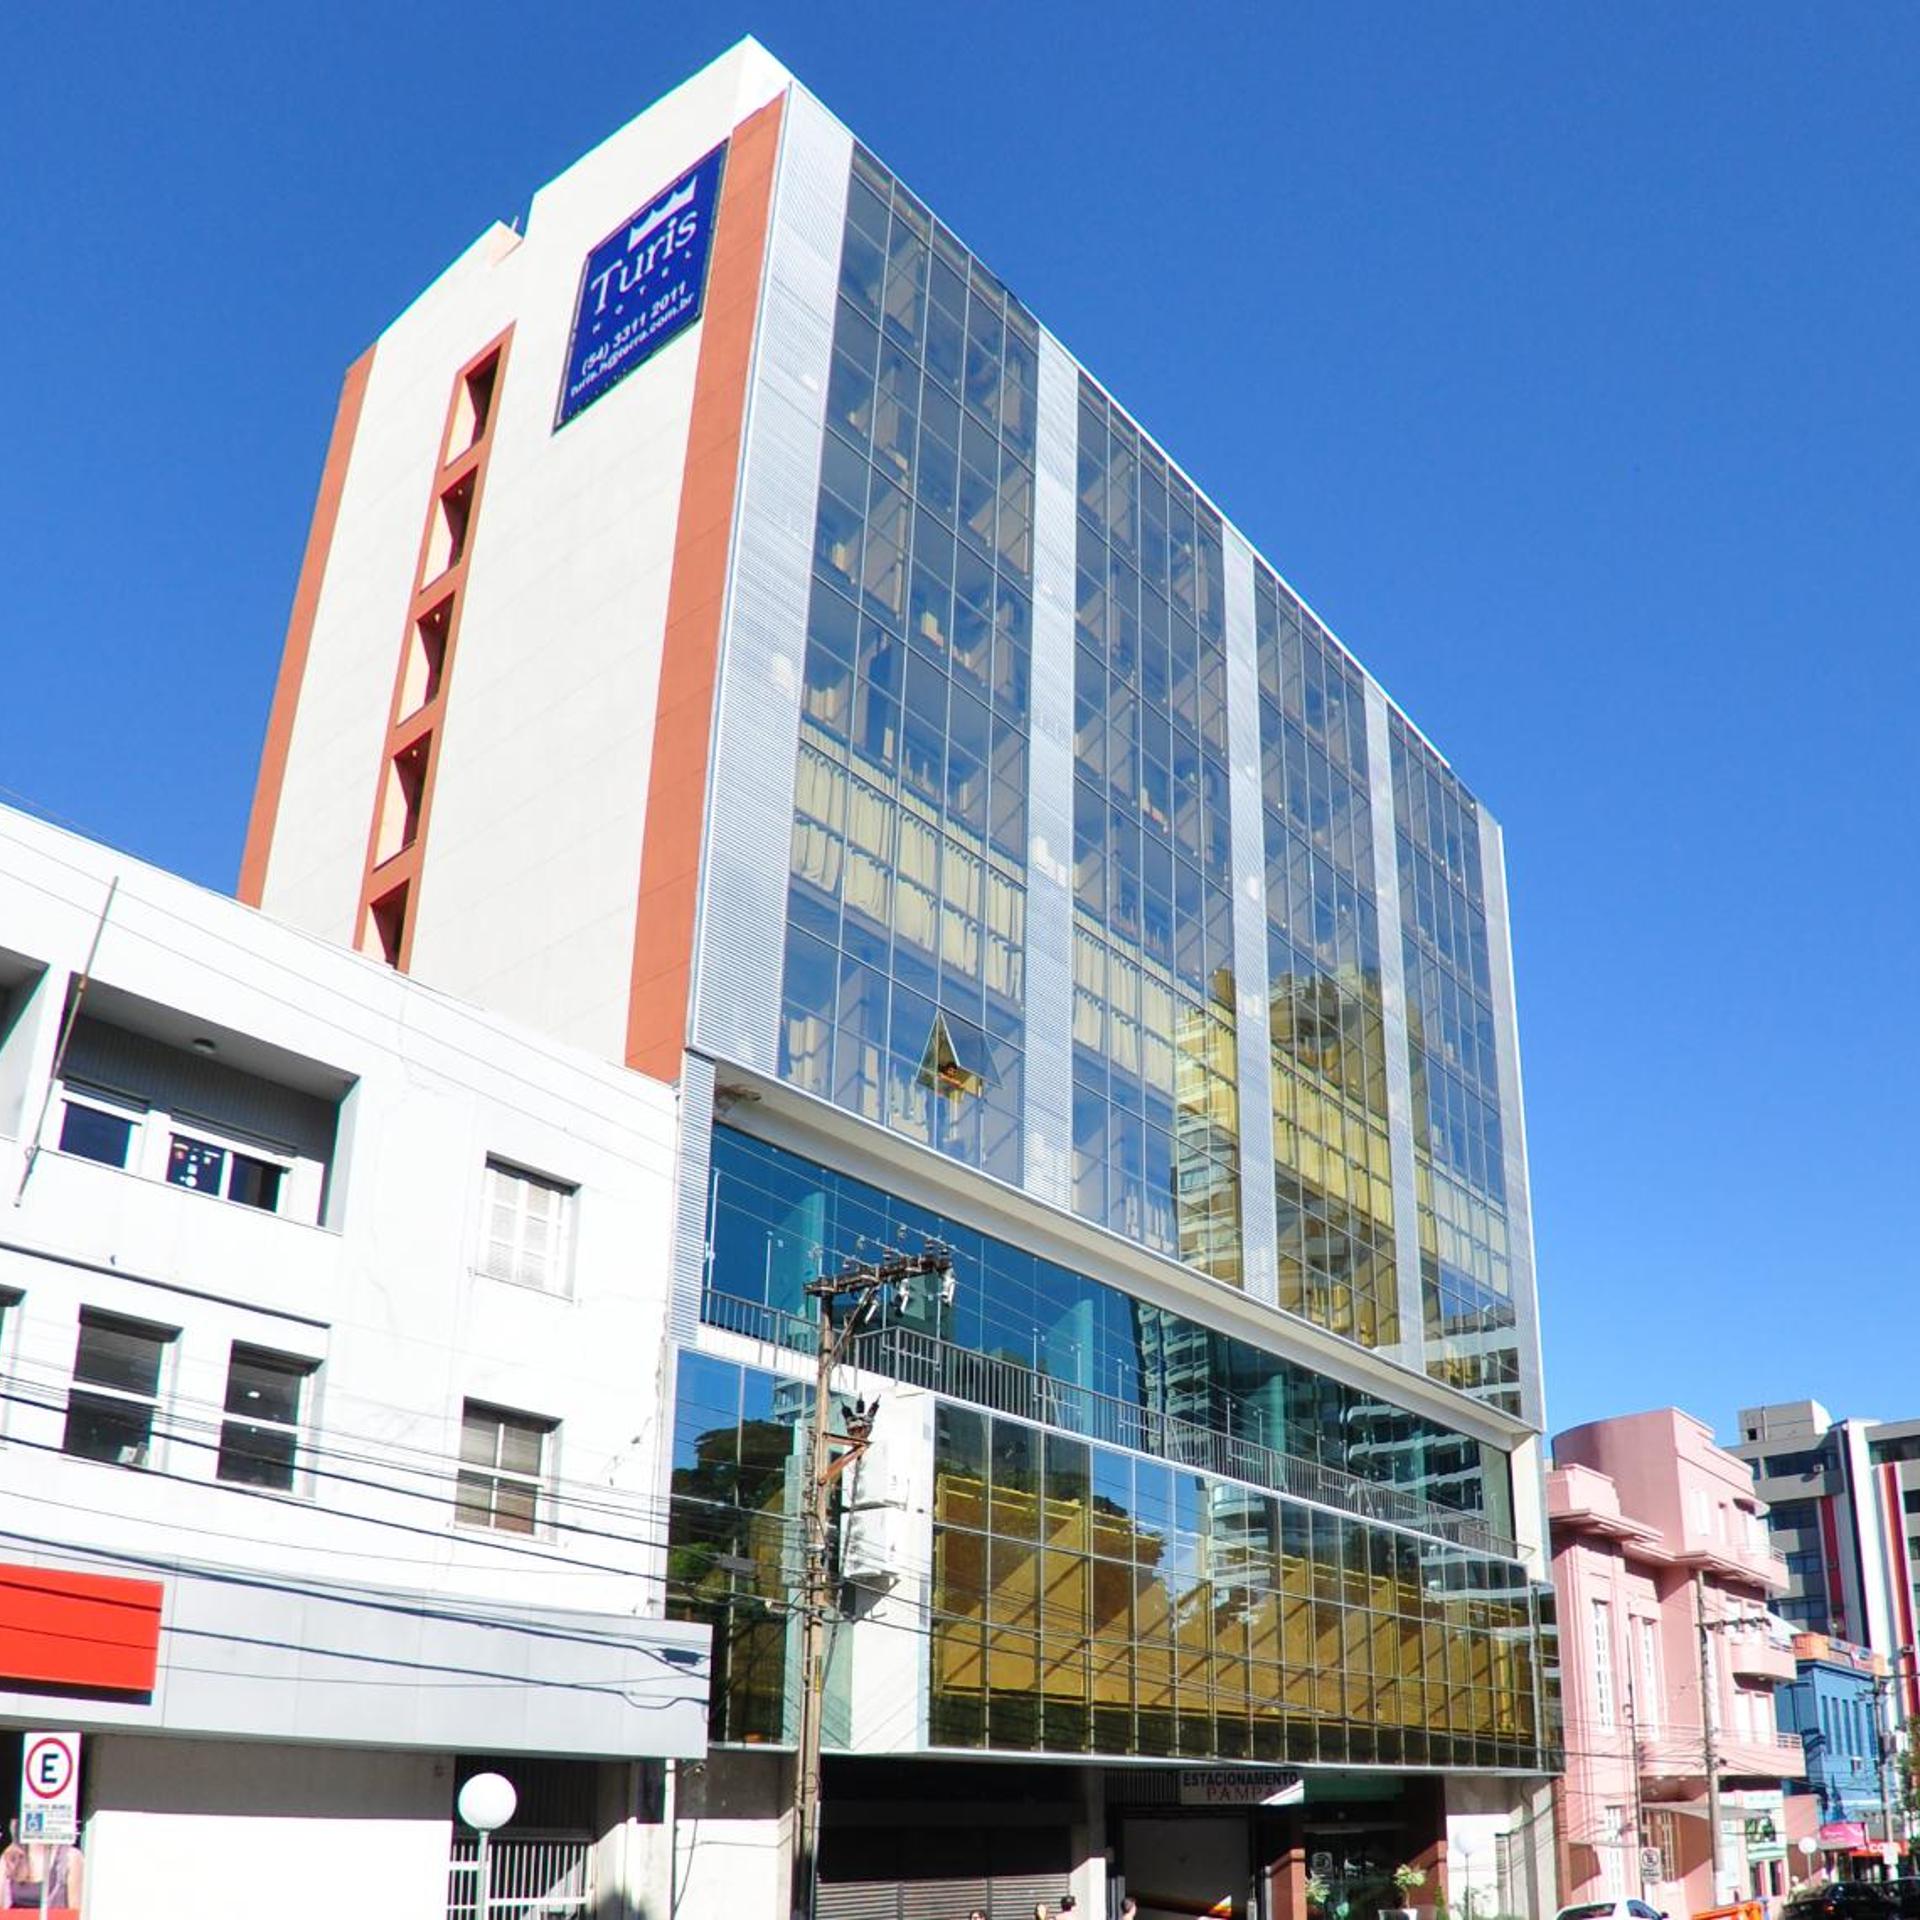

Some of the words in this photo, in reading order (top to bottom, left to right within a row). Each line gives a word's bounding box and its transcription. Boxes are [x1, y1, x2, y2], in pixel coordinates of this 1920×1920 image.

[591, 211, 697, 315] Turis
[613, 312, 646, 348] 3311
[651, 280, 686, 319] 2011
[41, 1754, 59, 1784] E
[1183, 1771, 1298, 1786] ESTACIONAMENTO
